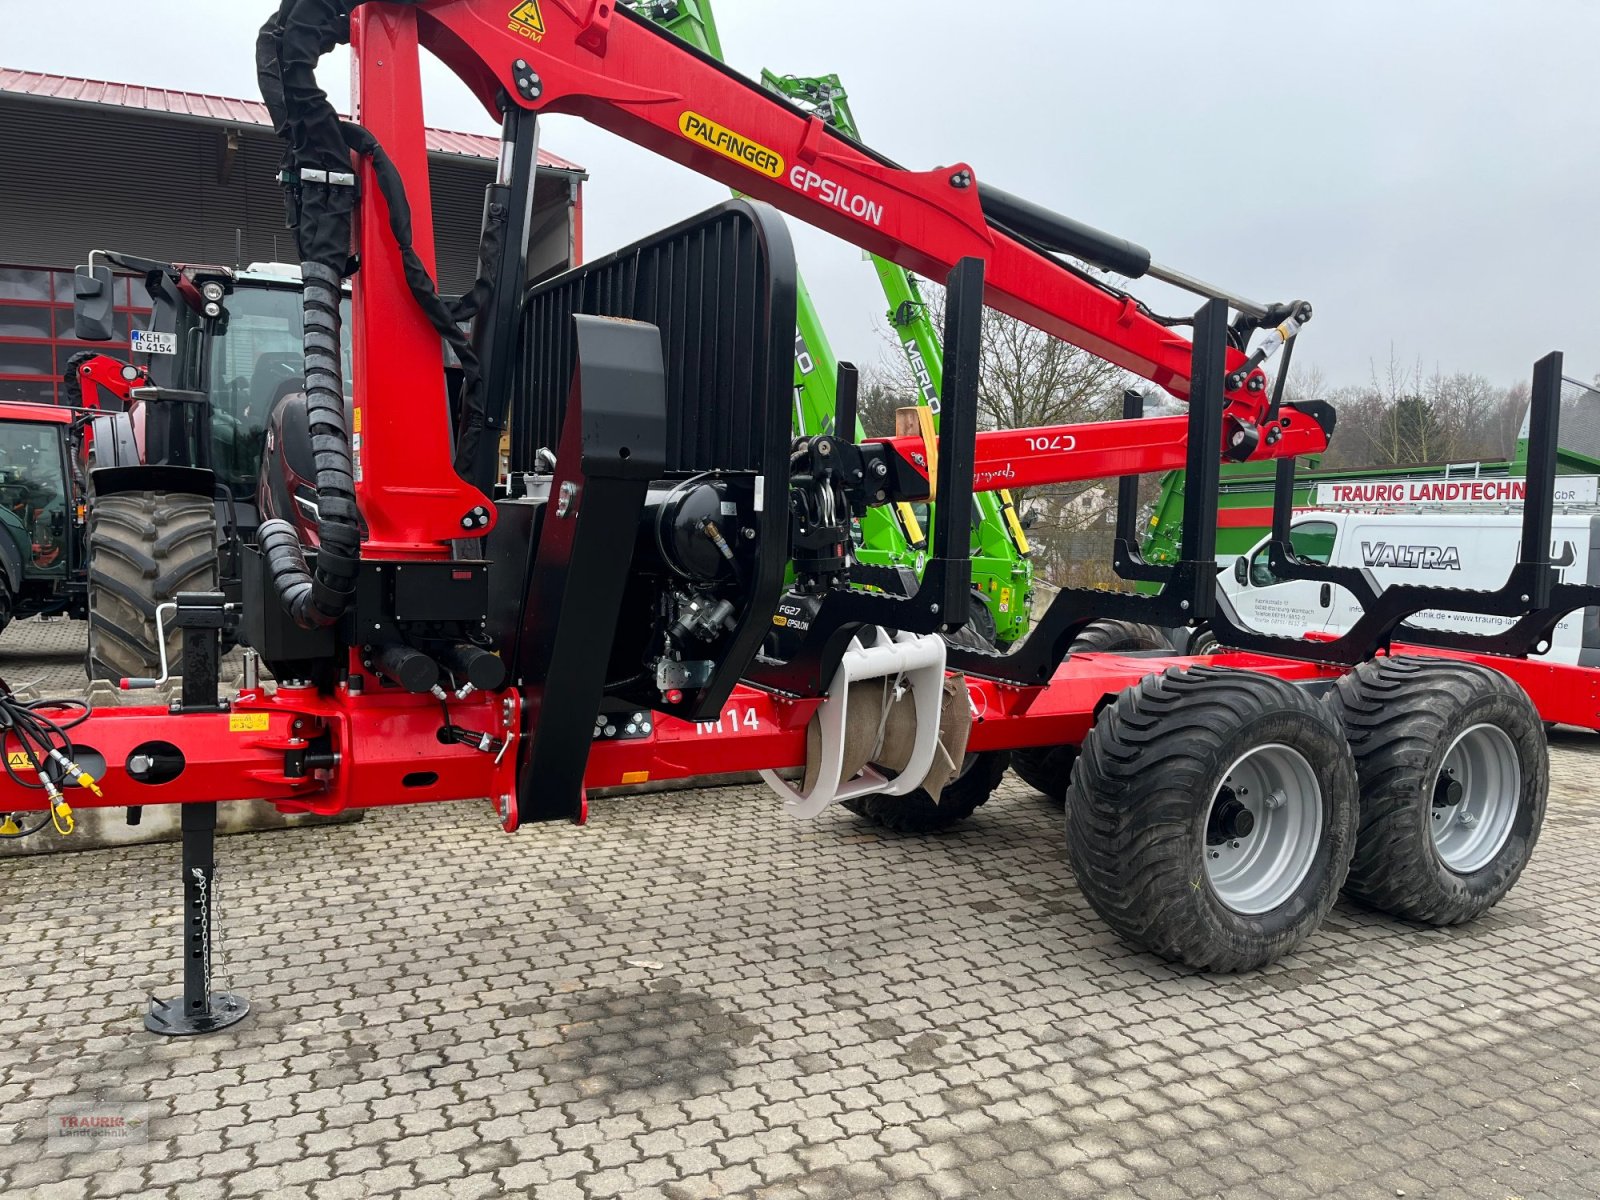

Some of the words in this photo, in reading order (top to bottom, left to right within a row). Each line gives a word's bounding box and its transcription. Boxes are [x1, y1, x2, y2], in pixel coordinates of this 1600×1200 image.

[507, 20, 542, 43] 20M
[685, 115, 779, 173] PALFINGER
[789, 165, 884, 226] EPSILON
[135, 341, 143, 350] G
[146, 342, 172, 352] 4154
[139, 332, 160, 343] KEH
[904, 338, 941, 415] MERLO
[1024, 435, 1077, 451] C70L
[1332, 484, 1404, 502] TRAURIG
[1409, 481, 1527, 501] LANDTECHN
[1554, 490, 1575, 500] GbR
[1361, 541, 1461, 571] VALTRA
[779, 604, 801, 616] FG27
[787, 619, 809, 630] EPSILON
[1453, 613, 1518, 626] www.traurig-lan
